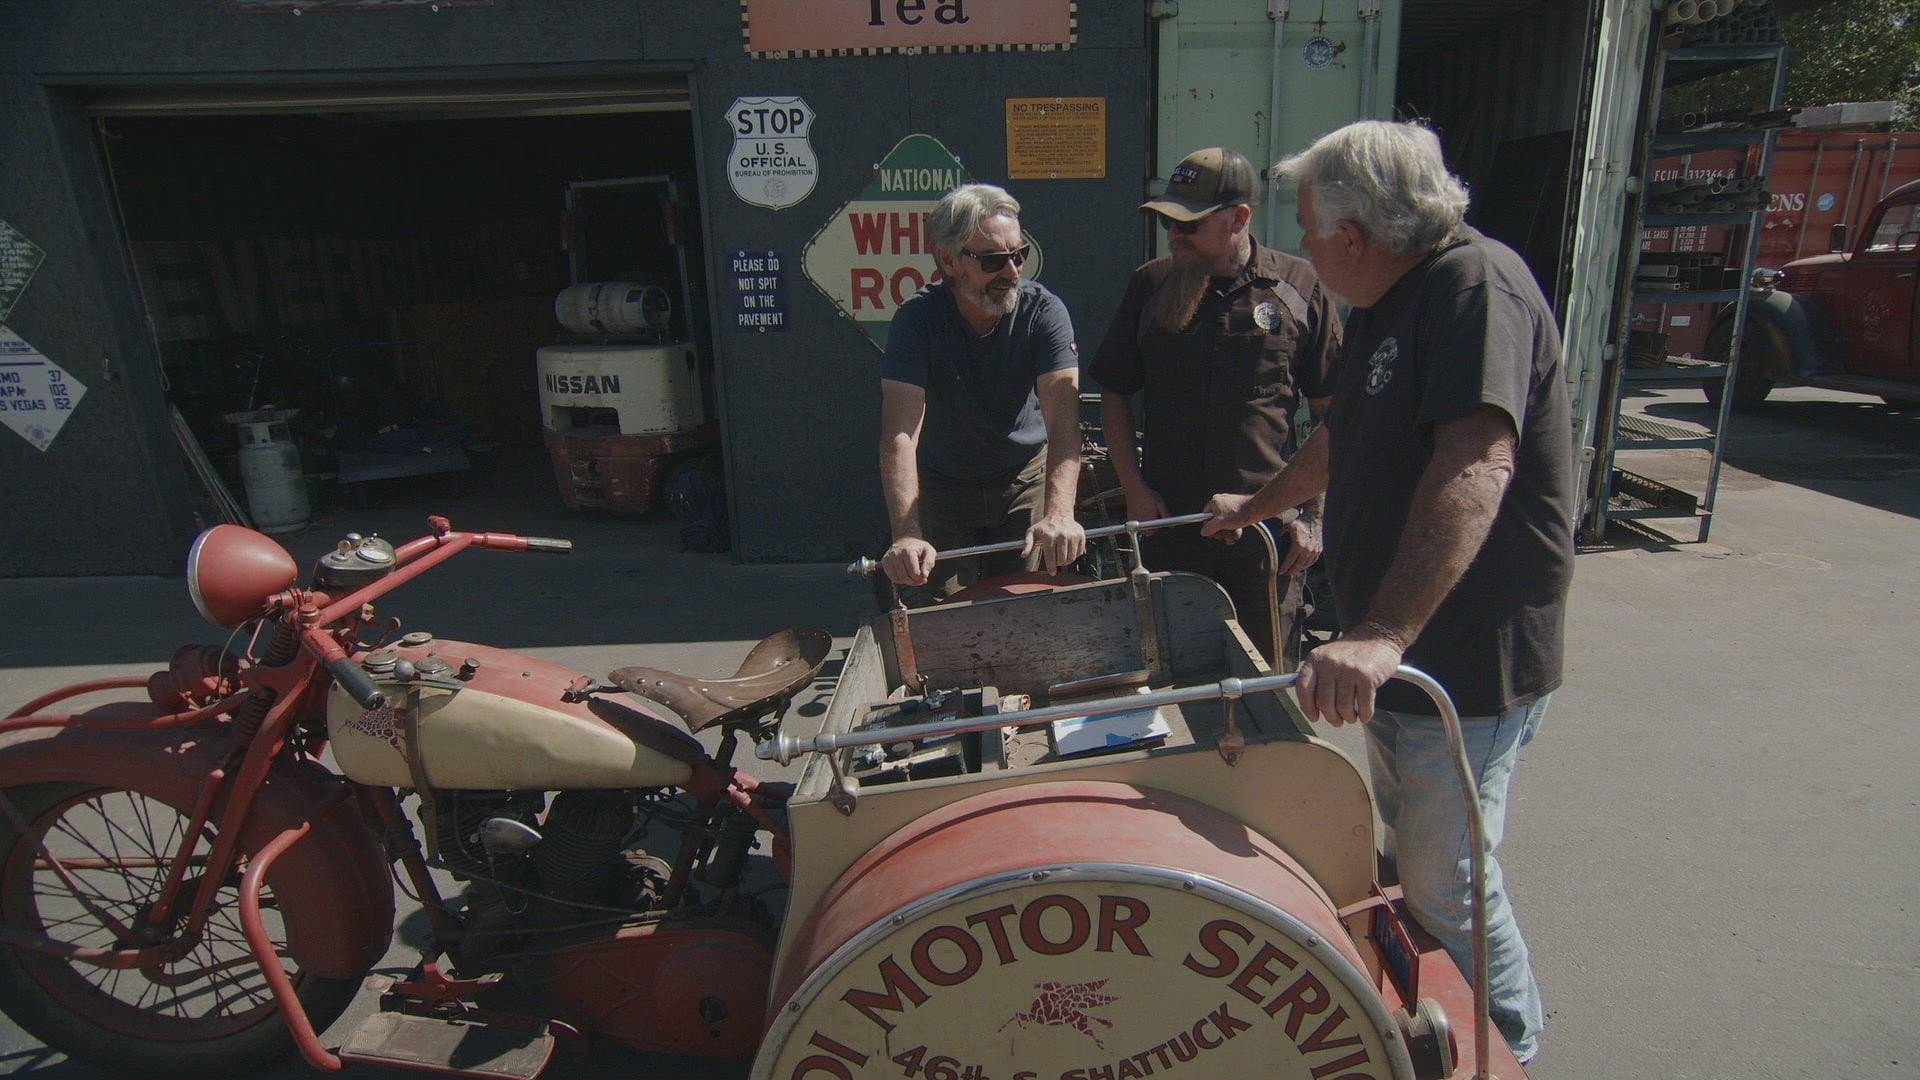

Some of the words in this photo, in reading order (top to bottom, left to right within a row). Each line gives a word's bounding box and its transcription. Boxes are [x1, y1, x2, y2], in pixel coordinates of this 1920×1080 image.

[1013, 103, 1027, 112] NO
[1029, 102, 1099, 112] TRESPASSING
[737, 108, 804, 135] STOP
[740, 157, 806, 168] OFFICIAL
[735, 170, 761, 178] BUREAU
[773, 169, 813, 177] PROHIBITION
[849, 212, 935, 256] WHI
[733, 259, 764, 272] PLEASE
[767, 258, 779, 271] DO
[738, 278, 754, 291] NOT
[758, 277, 776, 290] SPIT
[744, 295, 755, 308] ON
[759, 295, 775, 308] THE
[738, 313, 783, 326] PAVEMENT
[48, 370, 61, 382] 37
[49, 384, 68, 396] 102
[546, 374, 621, 394] NISSAN
[10, 400, 46, 411] VEGAS
[54, 398, 72, 410] 152
[840, 894, 1153, 1034] MOTOR
[1182, 918, 1376, 1080] SERVI
